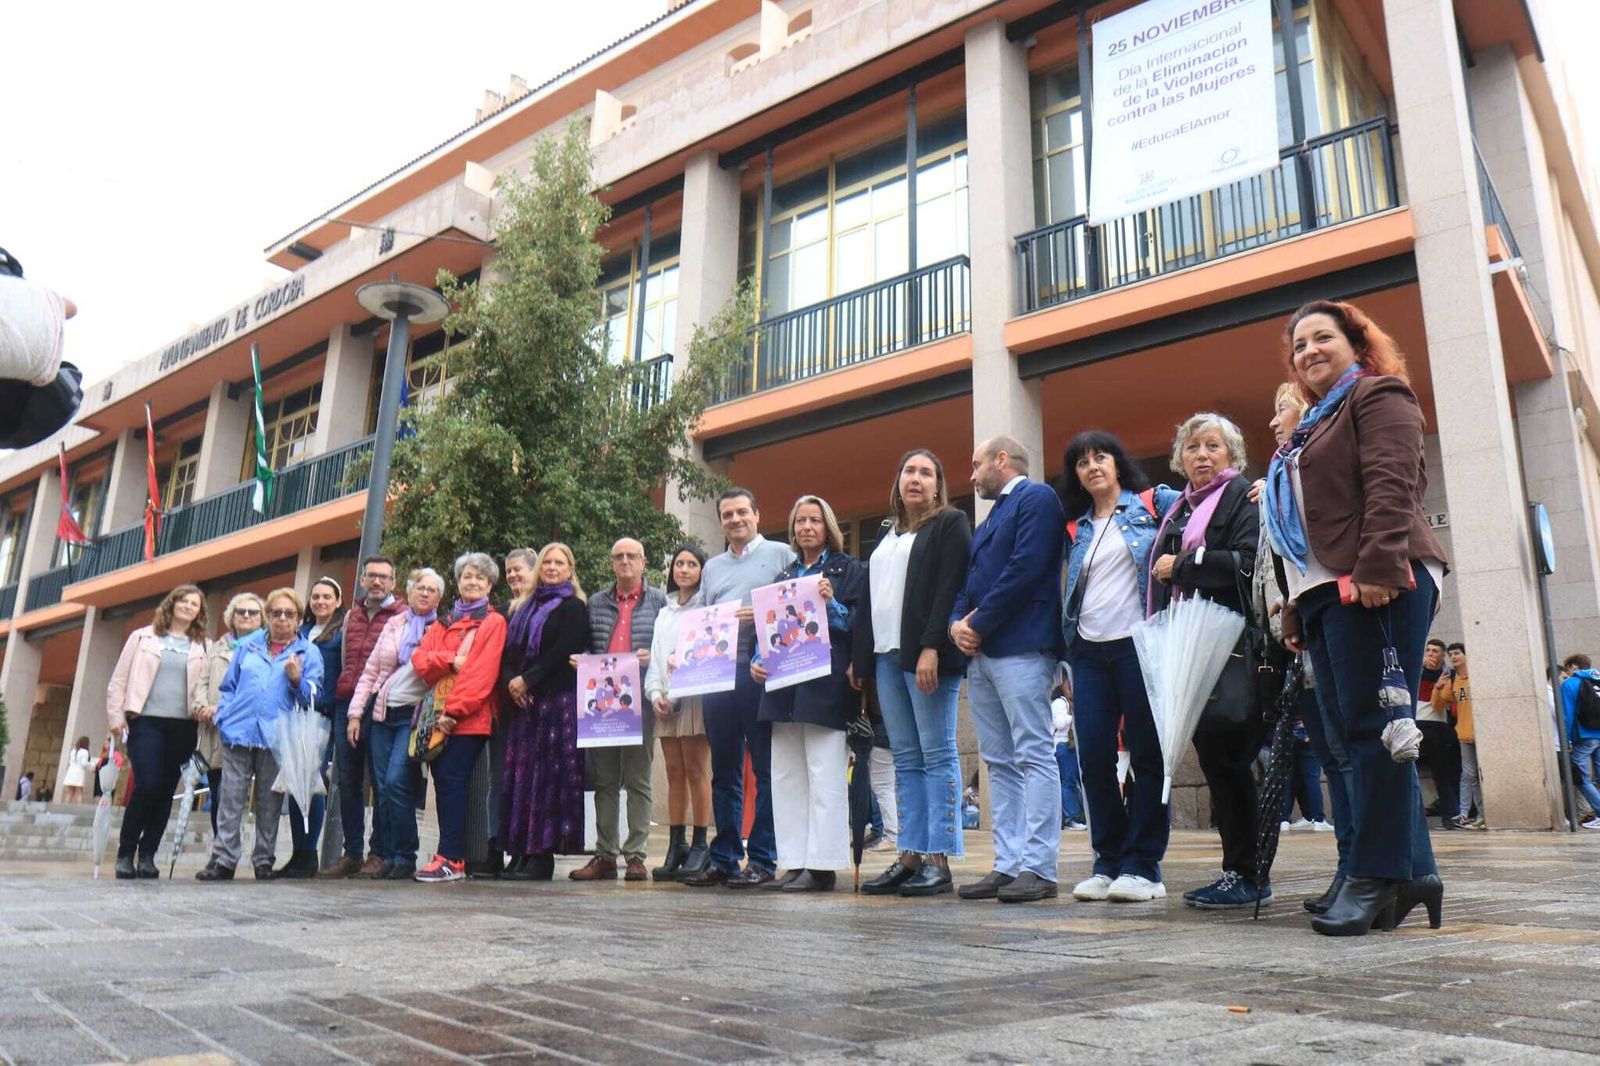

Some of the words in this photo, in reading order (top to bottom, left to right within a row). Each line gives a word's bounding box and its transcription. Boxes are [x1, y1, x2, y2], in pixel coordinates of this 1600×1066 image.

[1108, 39, 1128, 56] 25
[1133, 0, 1246, 47] NOVIEMBR
[1146, 21, 1243, 70] Internacional
[1107, 104, 1157, 127] contra
[1161, 91, 1185, 107] las
[1189, 64, 1256, 97] Mujeres
[1113, 84, 1132, 97] de
[1136, 78, 1148, 89] la
[1122, 94, 1142, 108] de
[1146, 88, 1159, 99] la
[1163, 56, 1238, 91] Violencia
[1131, 108, 1231, 150] #EducaElAmor
